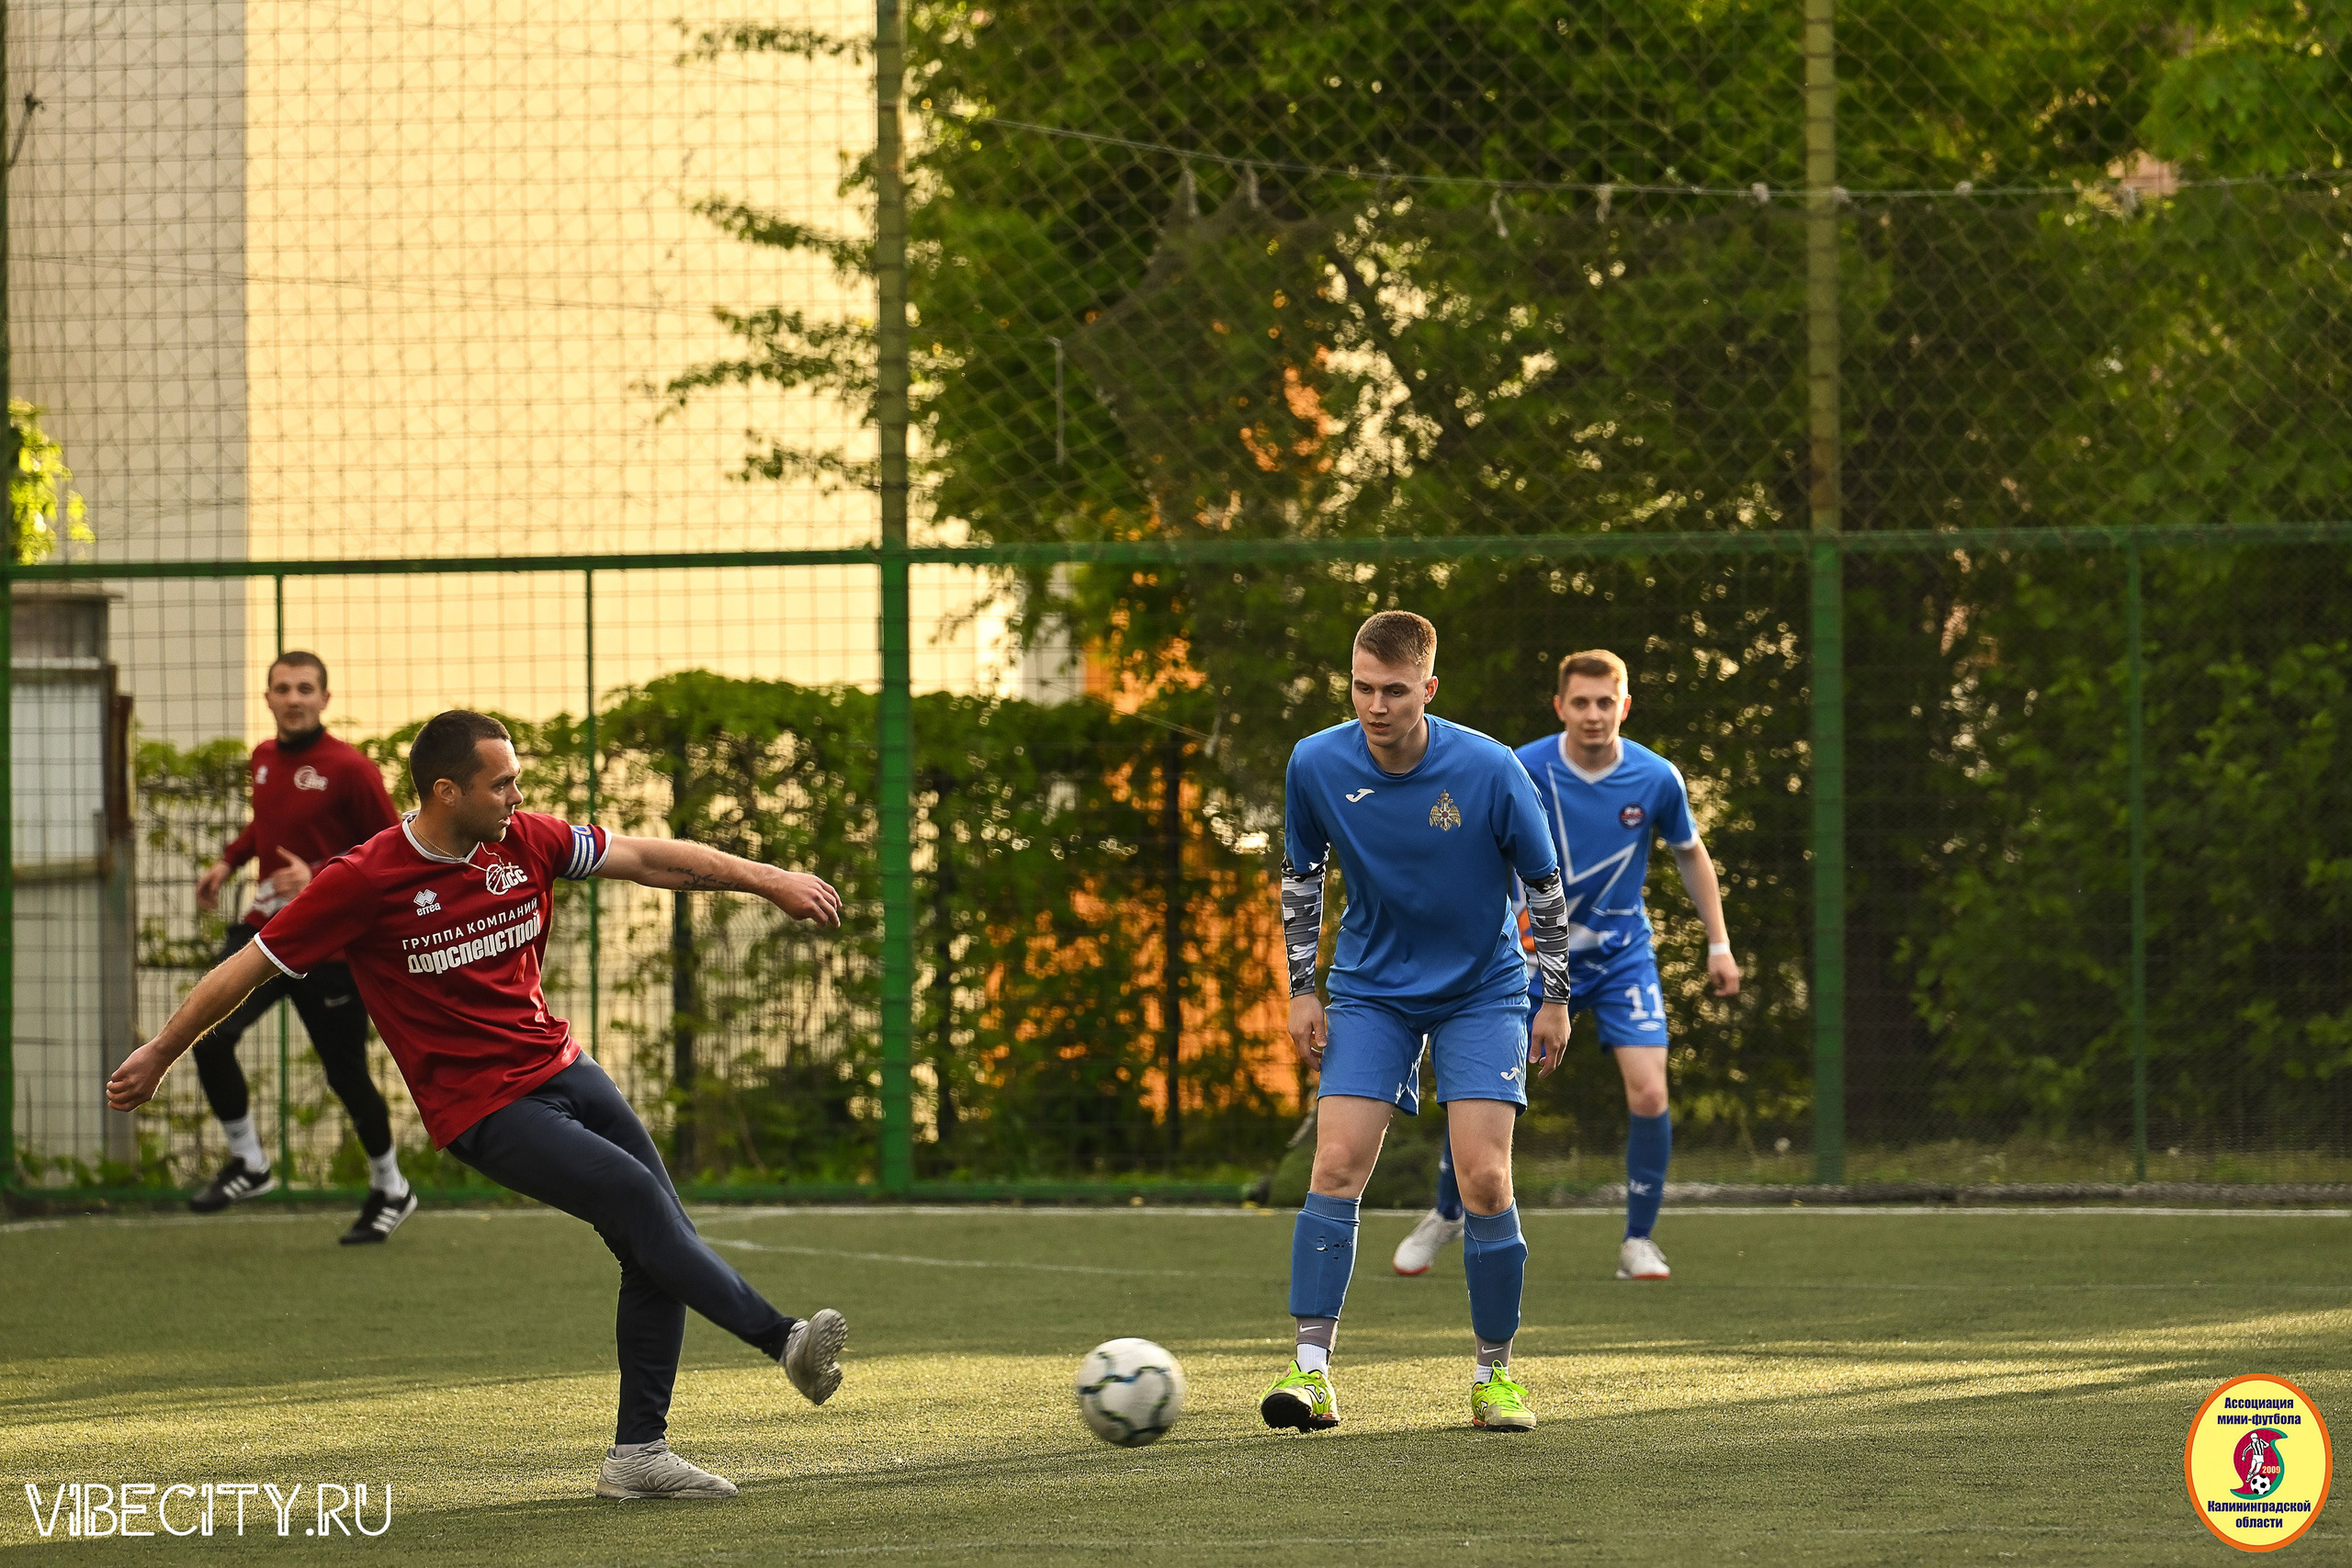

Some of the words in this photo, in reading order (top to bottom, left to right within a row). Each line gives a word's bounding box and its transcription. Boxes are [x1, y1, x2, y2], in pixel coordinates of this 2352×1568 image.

[402, 926, 464, 951] ГРУППА
[467, 897, 537, 935] КОМПАНИЙ
[416, 902, 441, 916] errea
[1624, 982, 1667, 1021] 11
